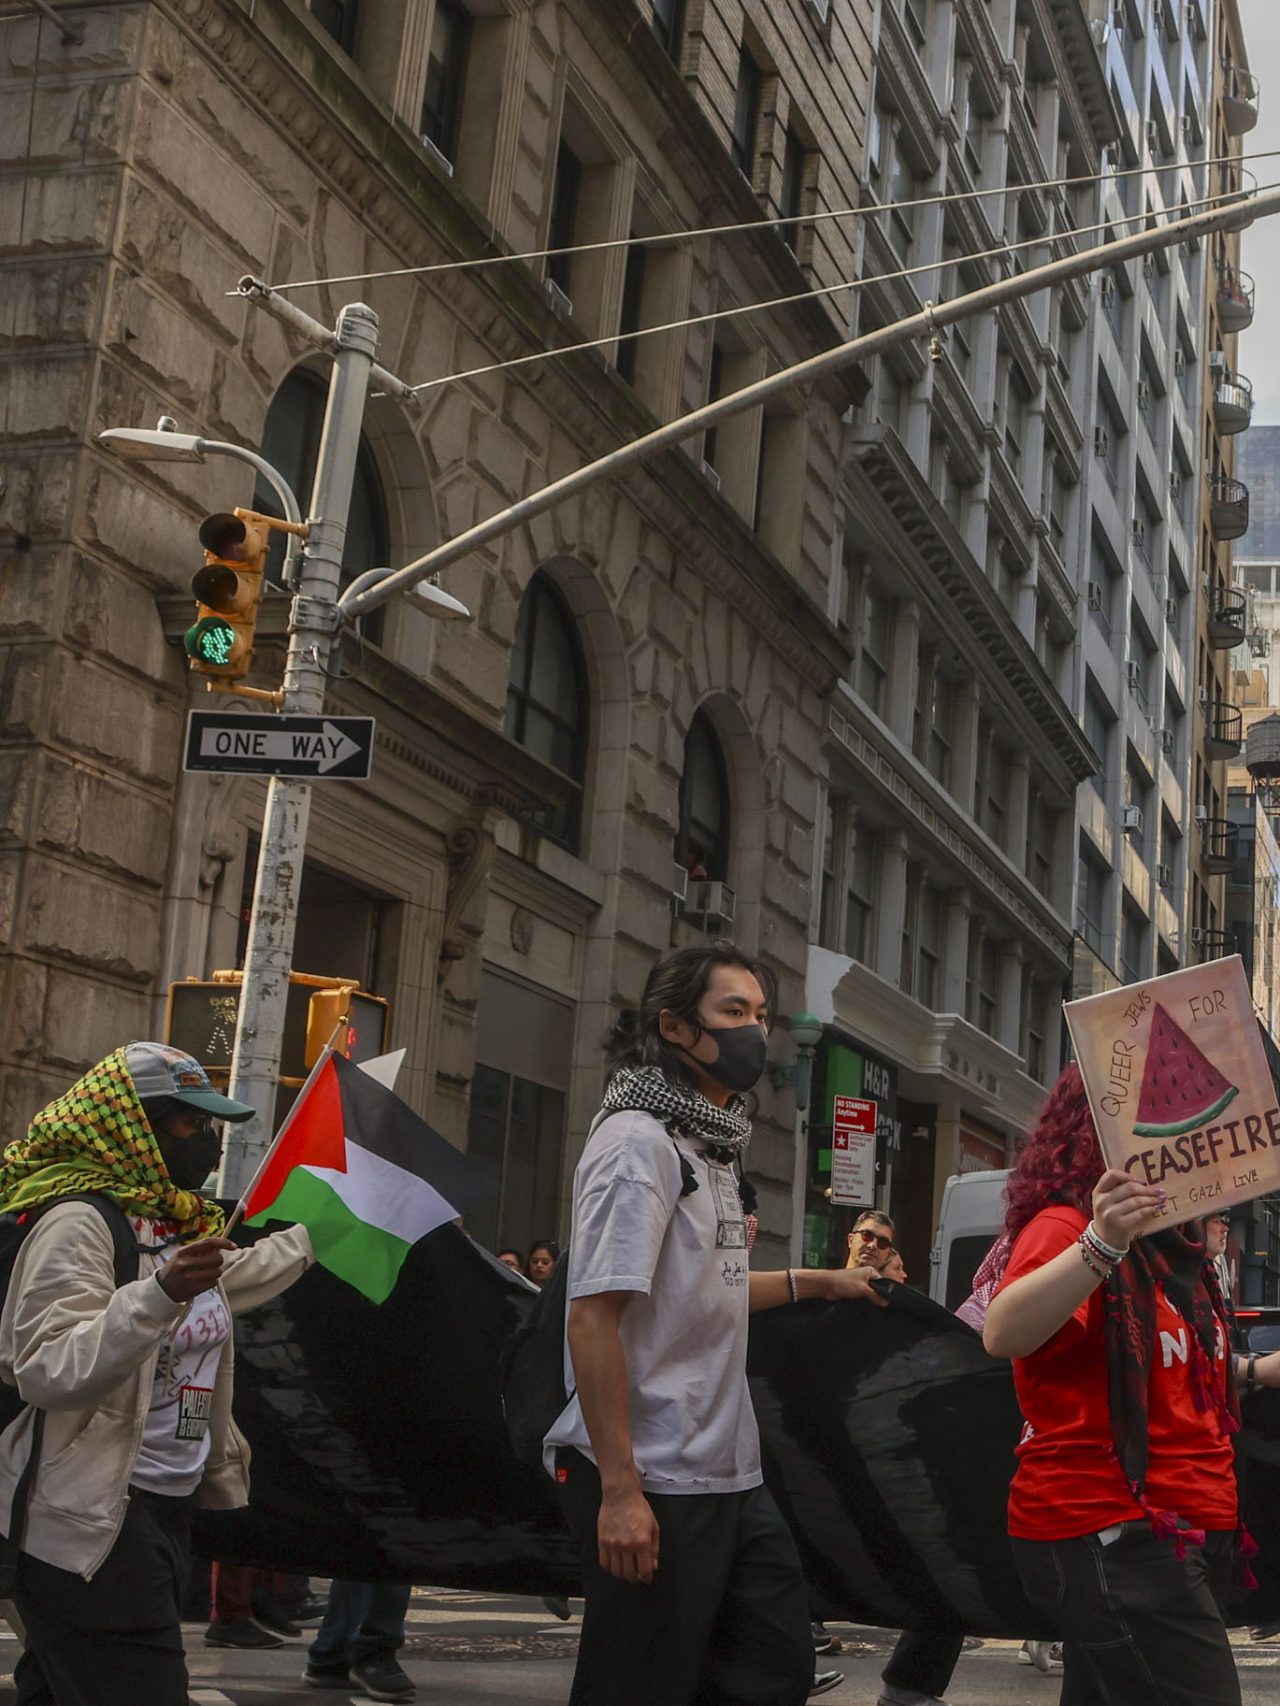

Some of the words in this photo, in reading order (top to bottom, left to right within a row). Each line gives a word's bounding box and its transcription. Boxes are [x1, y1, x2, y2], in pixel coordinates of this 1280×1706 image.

[216, 731, 267, 755] ONE
[292, 736, 344, 758] WAY
[1123, 989, 1151, 1028] JEWS
[1188, 989, 1227, 1022] FOR
[863, 1059, 889, 1100] H&R
[1100, 1039, 1137, 1117] QUEER
[837, 1099, 845, 1108] NO
[845, 1101, 870, 1112] STANDING
[1189, 1180, 1223, 1203] GAZA
[1232, 1168, 1259, 1189] LIVE
